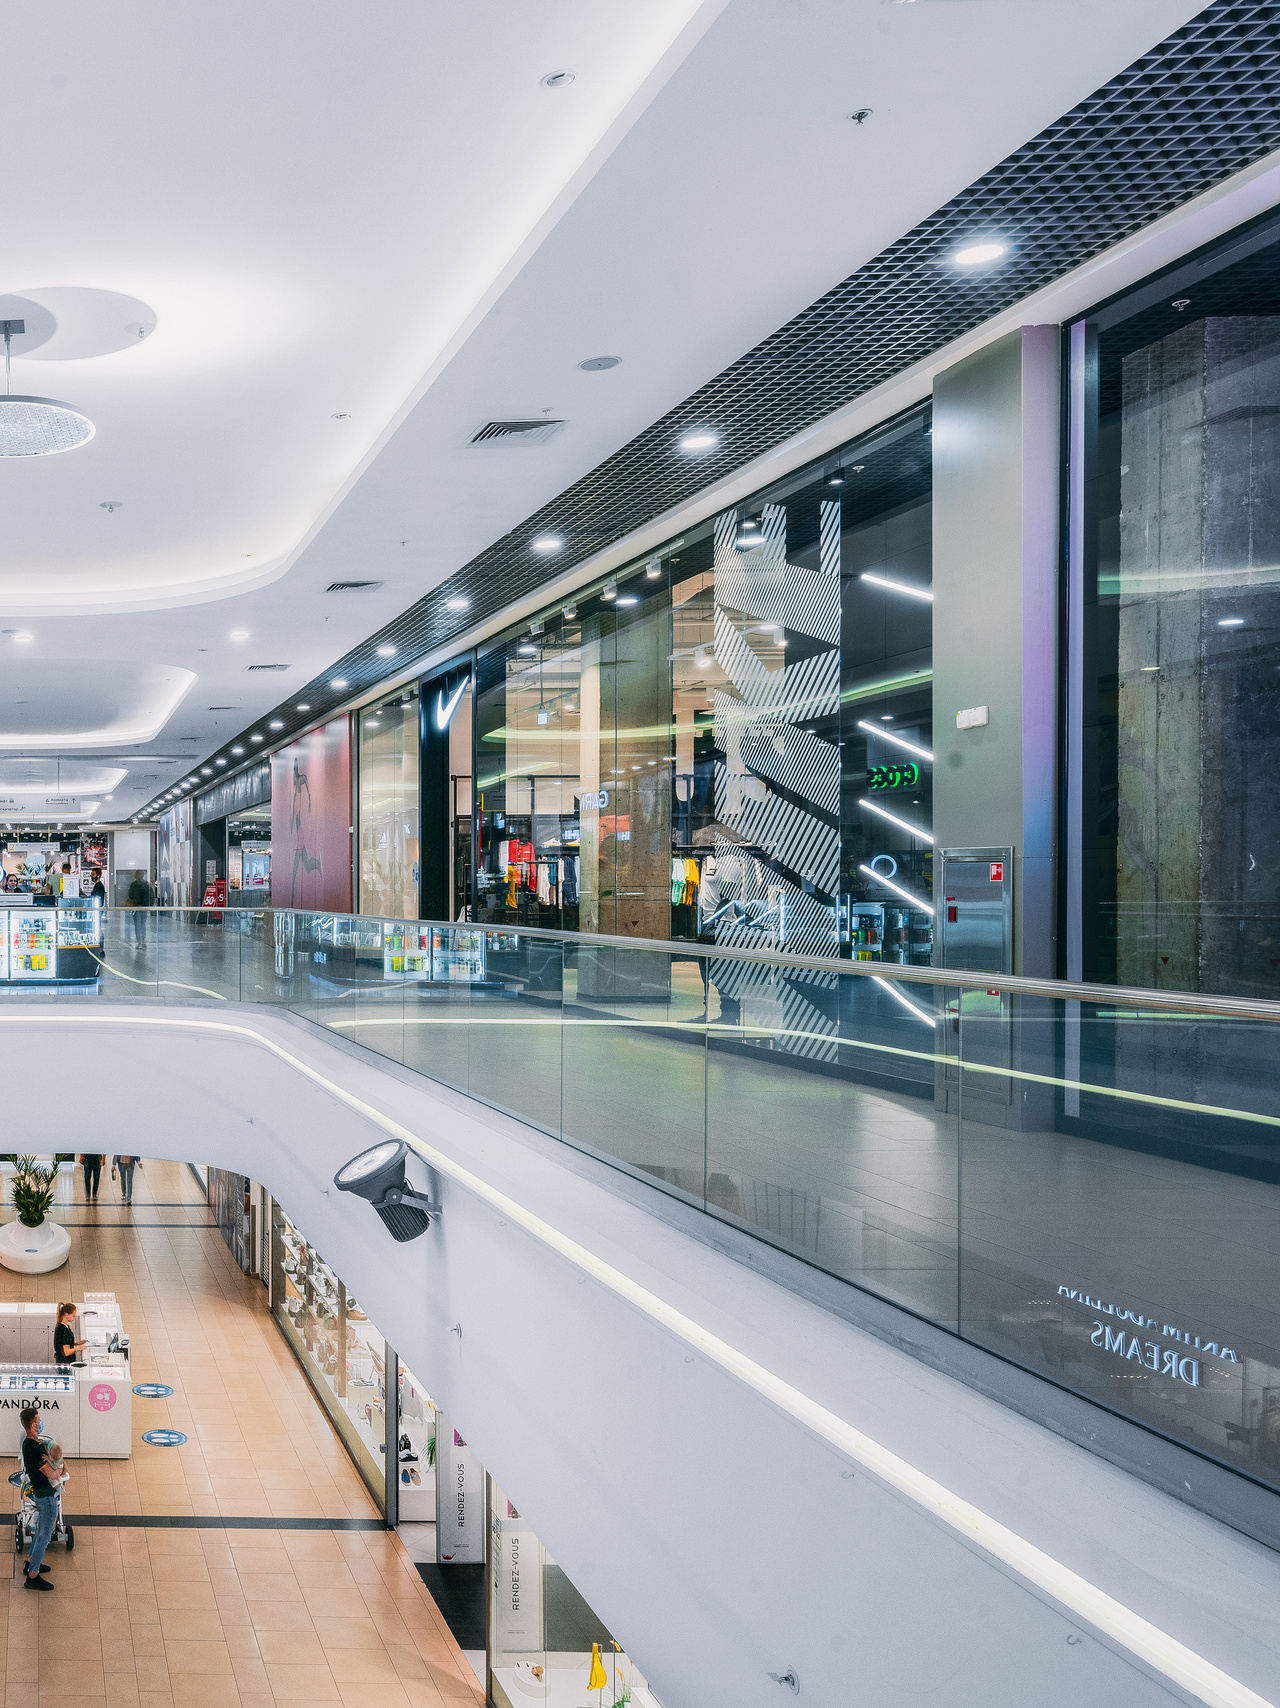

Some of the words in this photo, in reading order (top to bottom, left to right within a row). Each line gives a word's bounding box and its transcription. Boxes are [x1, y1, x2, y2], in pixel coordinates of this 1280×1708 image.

[9, 843, 15, 851] 2
[457, 1463, 466, 1528] RENDEZ-VOUS
[511, 1537, 520, 1611] RENDEZ-VOUS
